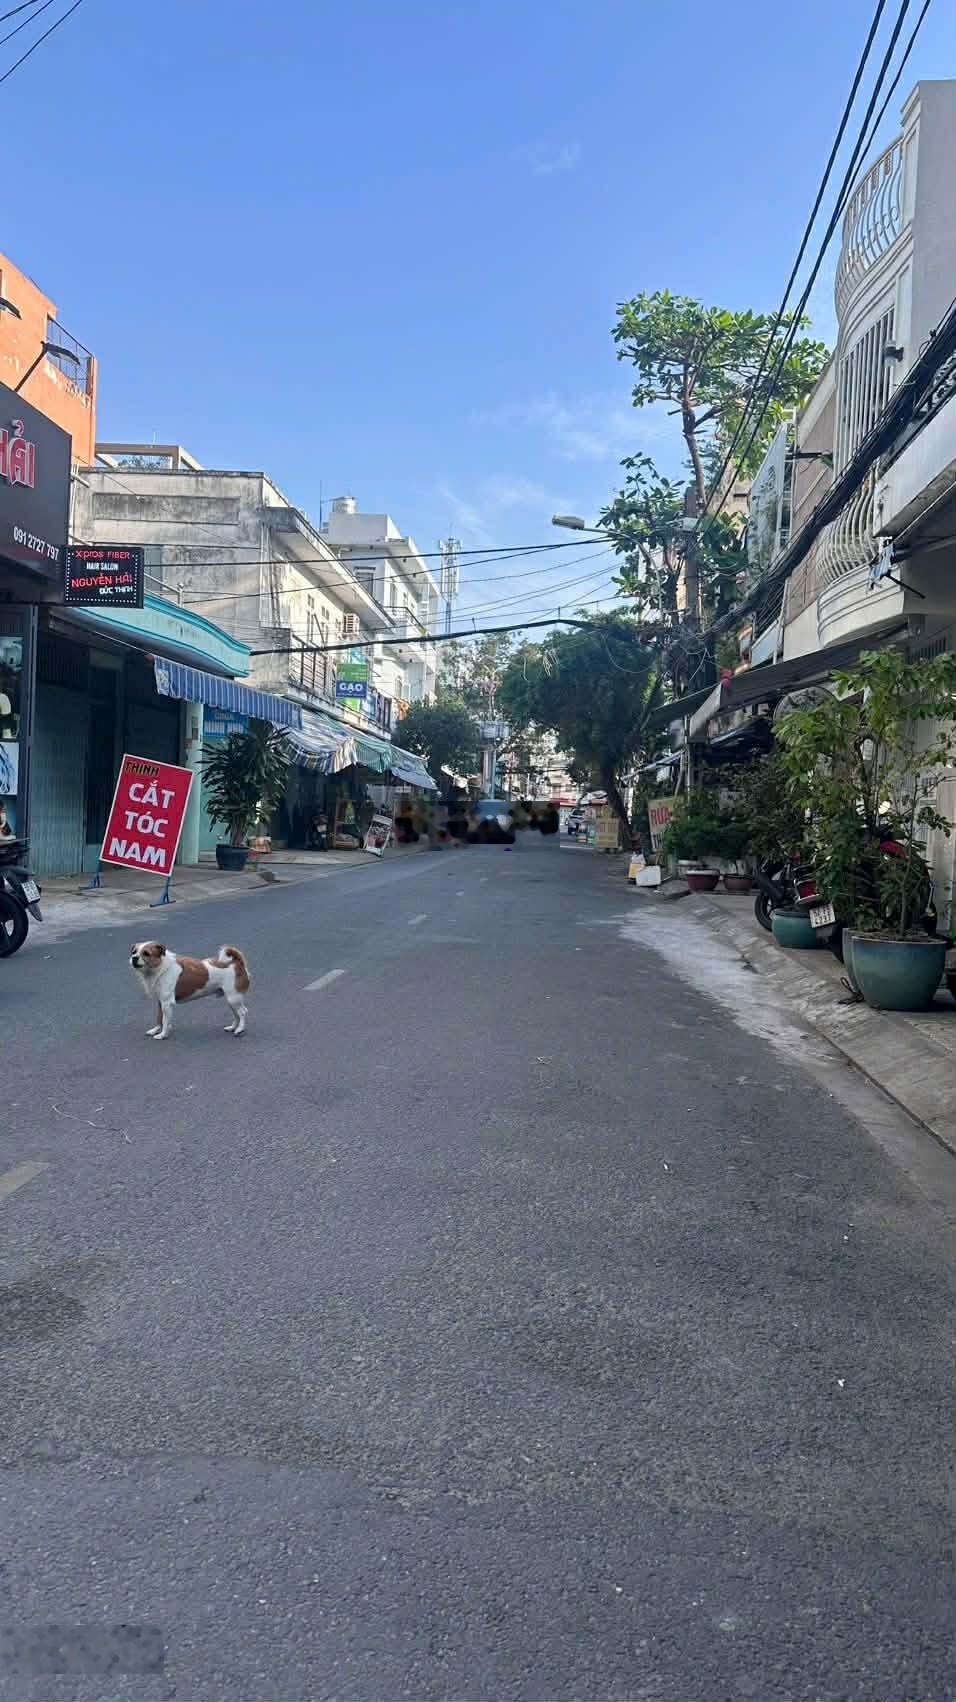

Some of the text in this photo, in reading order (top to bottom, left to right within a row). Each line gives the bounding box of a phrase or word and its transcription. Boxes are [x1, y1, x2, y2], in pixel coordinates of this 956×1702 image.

[13, 526, 60, 561] 091 2727 797
[107, 551, 130, 560] FIBER
[86, 561, 119, 571] HAIR SALON
[128, 780, 176, 809] CẮT
[125, 810, 169, 838] TÓC
[109, 837, 167, 868] NAM
